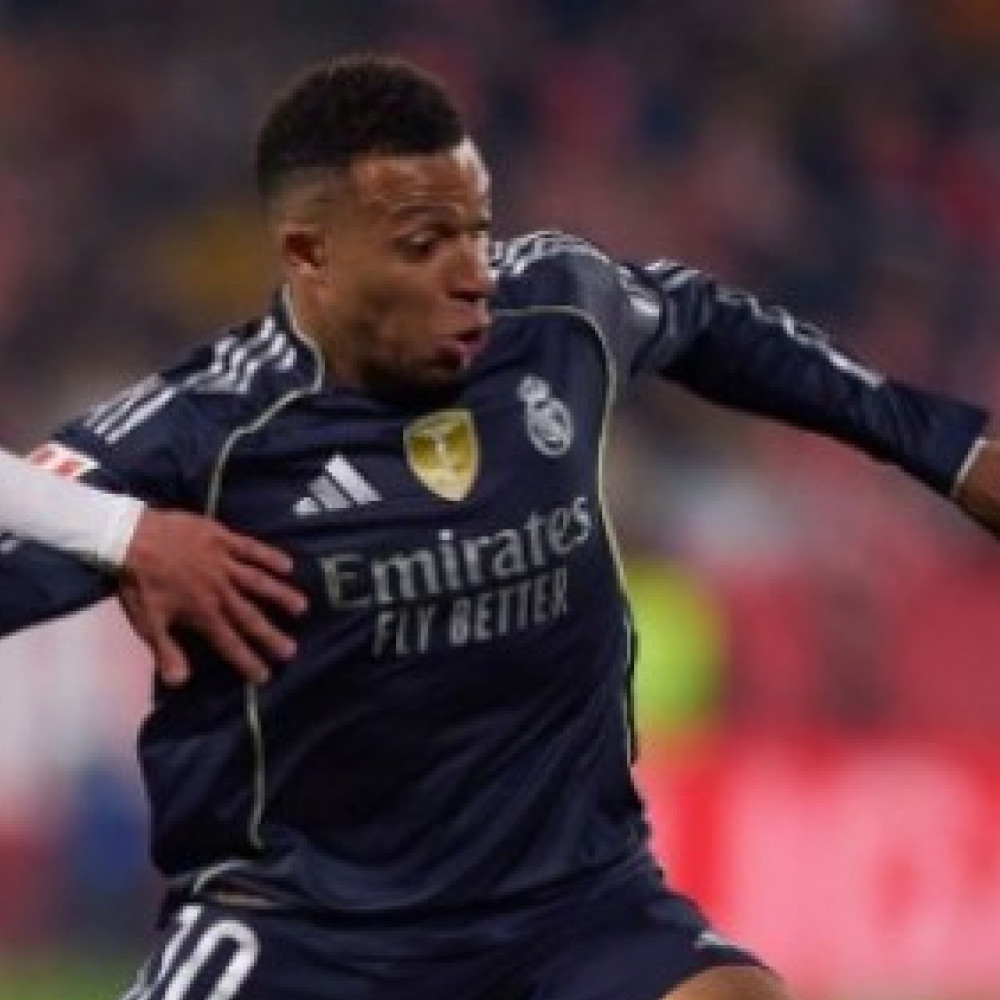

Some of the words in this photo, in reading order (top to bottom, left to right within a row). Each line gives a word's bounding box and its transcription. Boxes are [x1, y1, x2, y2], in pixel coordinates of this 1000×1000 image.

[318, 496, 593, 610] Emirates
[371, 604, 438, 657] FLY
[447, 567, 570, 647] BETTER
